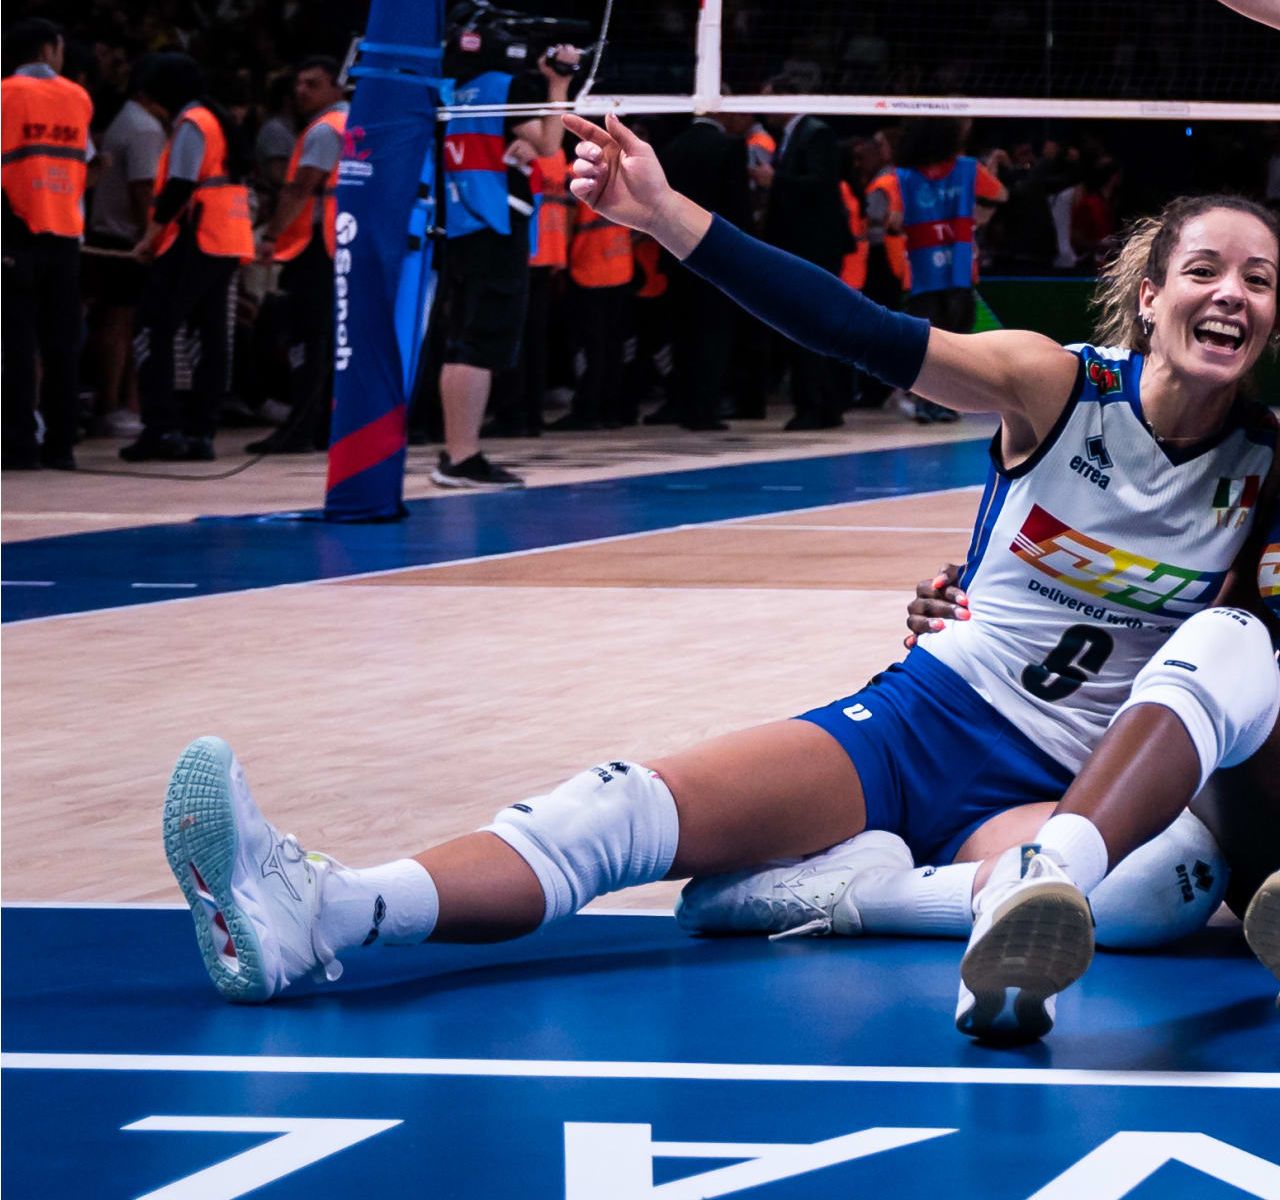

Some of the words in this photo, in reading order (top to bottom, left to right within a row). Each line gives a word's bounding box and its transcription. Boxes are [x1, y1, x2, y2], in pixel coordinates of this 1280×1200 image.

[1068, 451, 1111, 491] errea
[1040, 535, 1212, 614] DHL
[1027, 578, 1108, 623] Delivered
[1107, 609, 1145, 632] with
[1212, 610, 1249, 627] errea
[1175, 863, 1195, 905] errea
